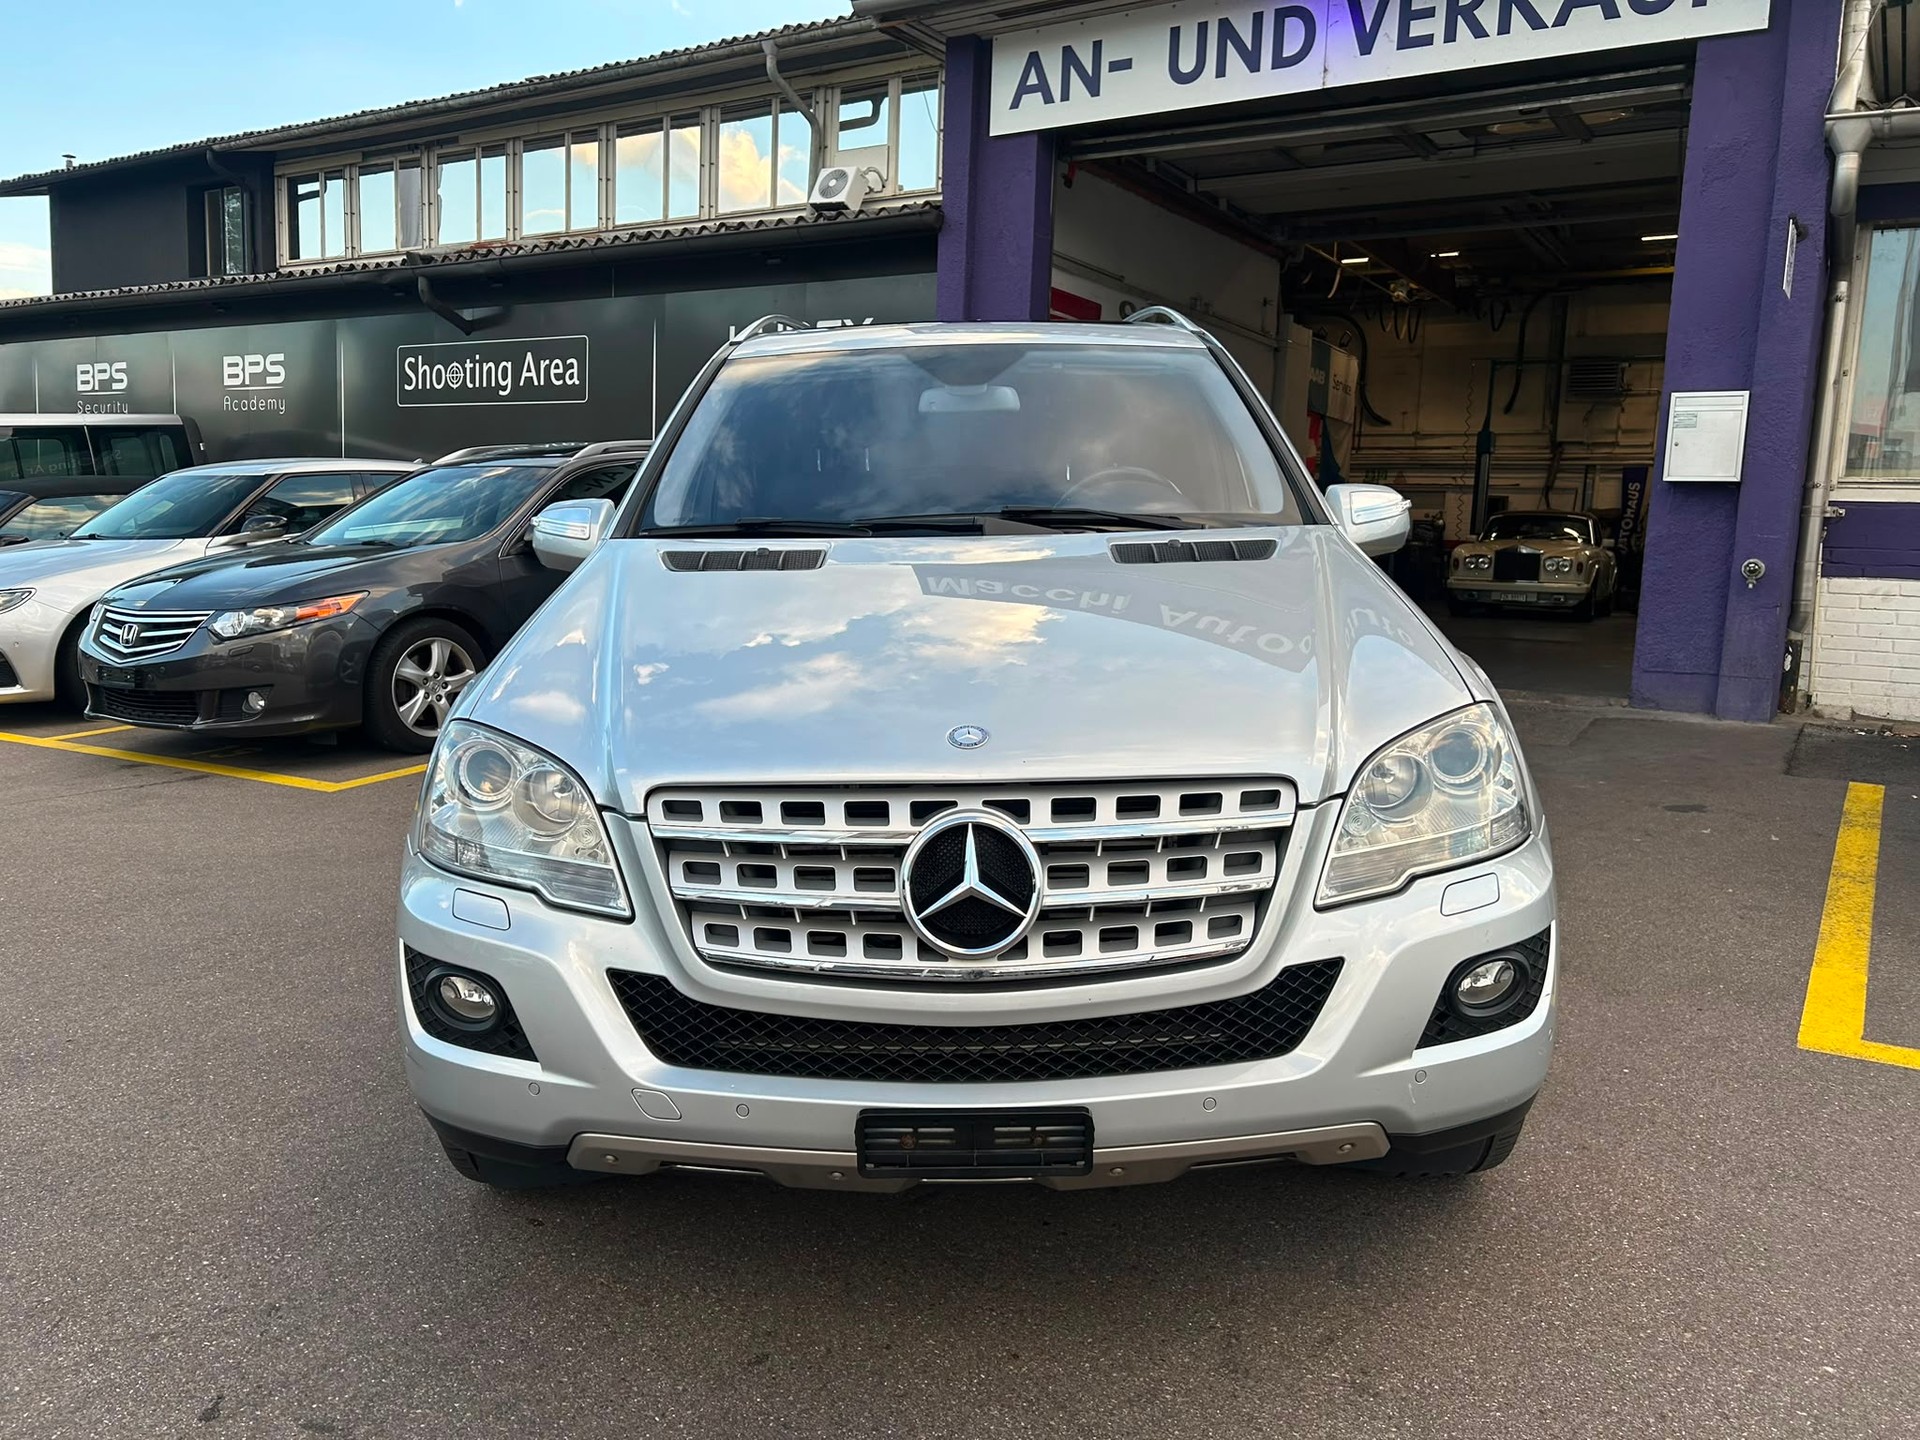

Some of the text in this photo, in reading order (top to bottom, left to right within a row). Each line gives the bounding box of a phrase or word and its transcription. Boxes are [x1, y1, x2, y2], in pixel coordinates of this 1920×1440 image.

[1009, 0, 1707, 110] AN- UND VERK
[76, 361, 128, 391] BPS
[222, 353, 286, 386] BPS
[404, 352, 580, 396] Shooting Area
[77, 400, 128, 414] Security
[223, 395, 286, 415] Academy
